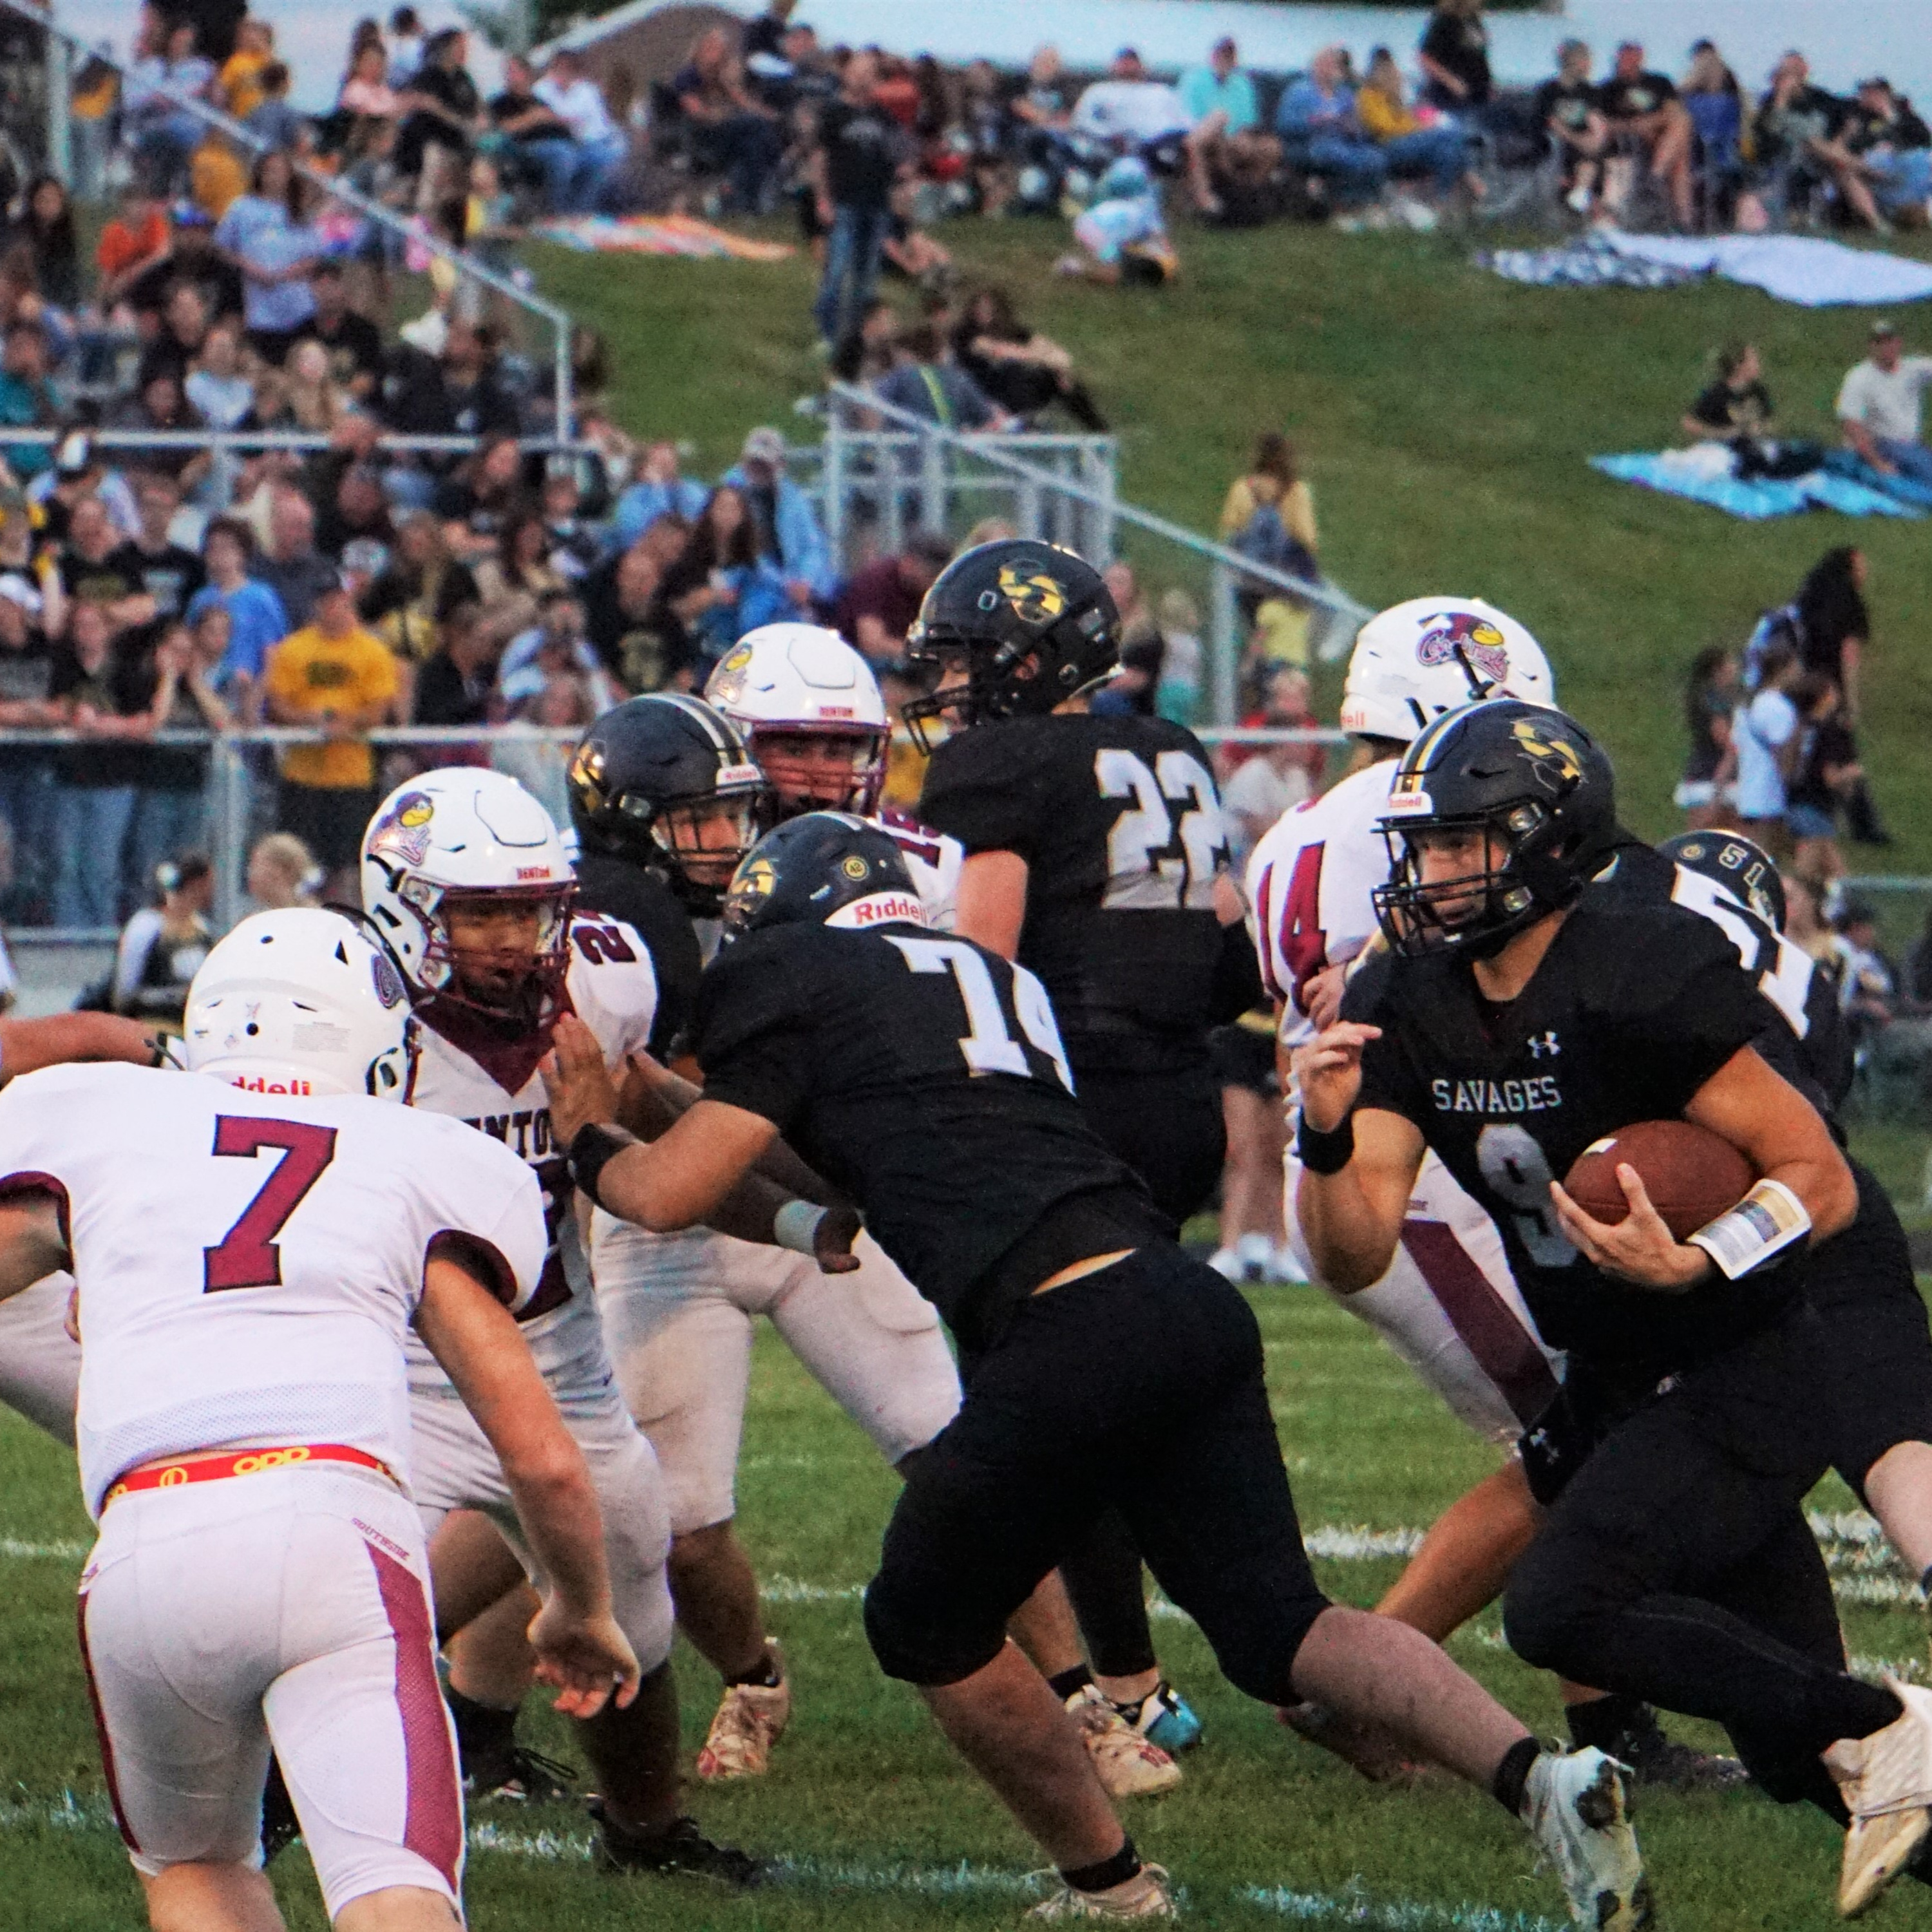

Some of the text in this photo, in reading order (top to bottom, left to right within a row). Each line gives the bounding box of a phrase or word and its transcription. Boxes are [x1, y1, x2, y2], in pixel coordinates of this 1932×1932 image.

[1094, 749, 1224, 909] 22
[854, 898, 927, 927] Riddell
[457, 1108, 558, 1159] NTO
[1432, 1076, 1562, 1113] SAVAGES
[202, 1115, 338, 1294] 7
[1476, 1122, 1578, 1267] 9
